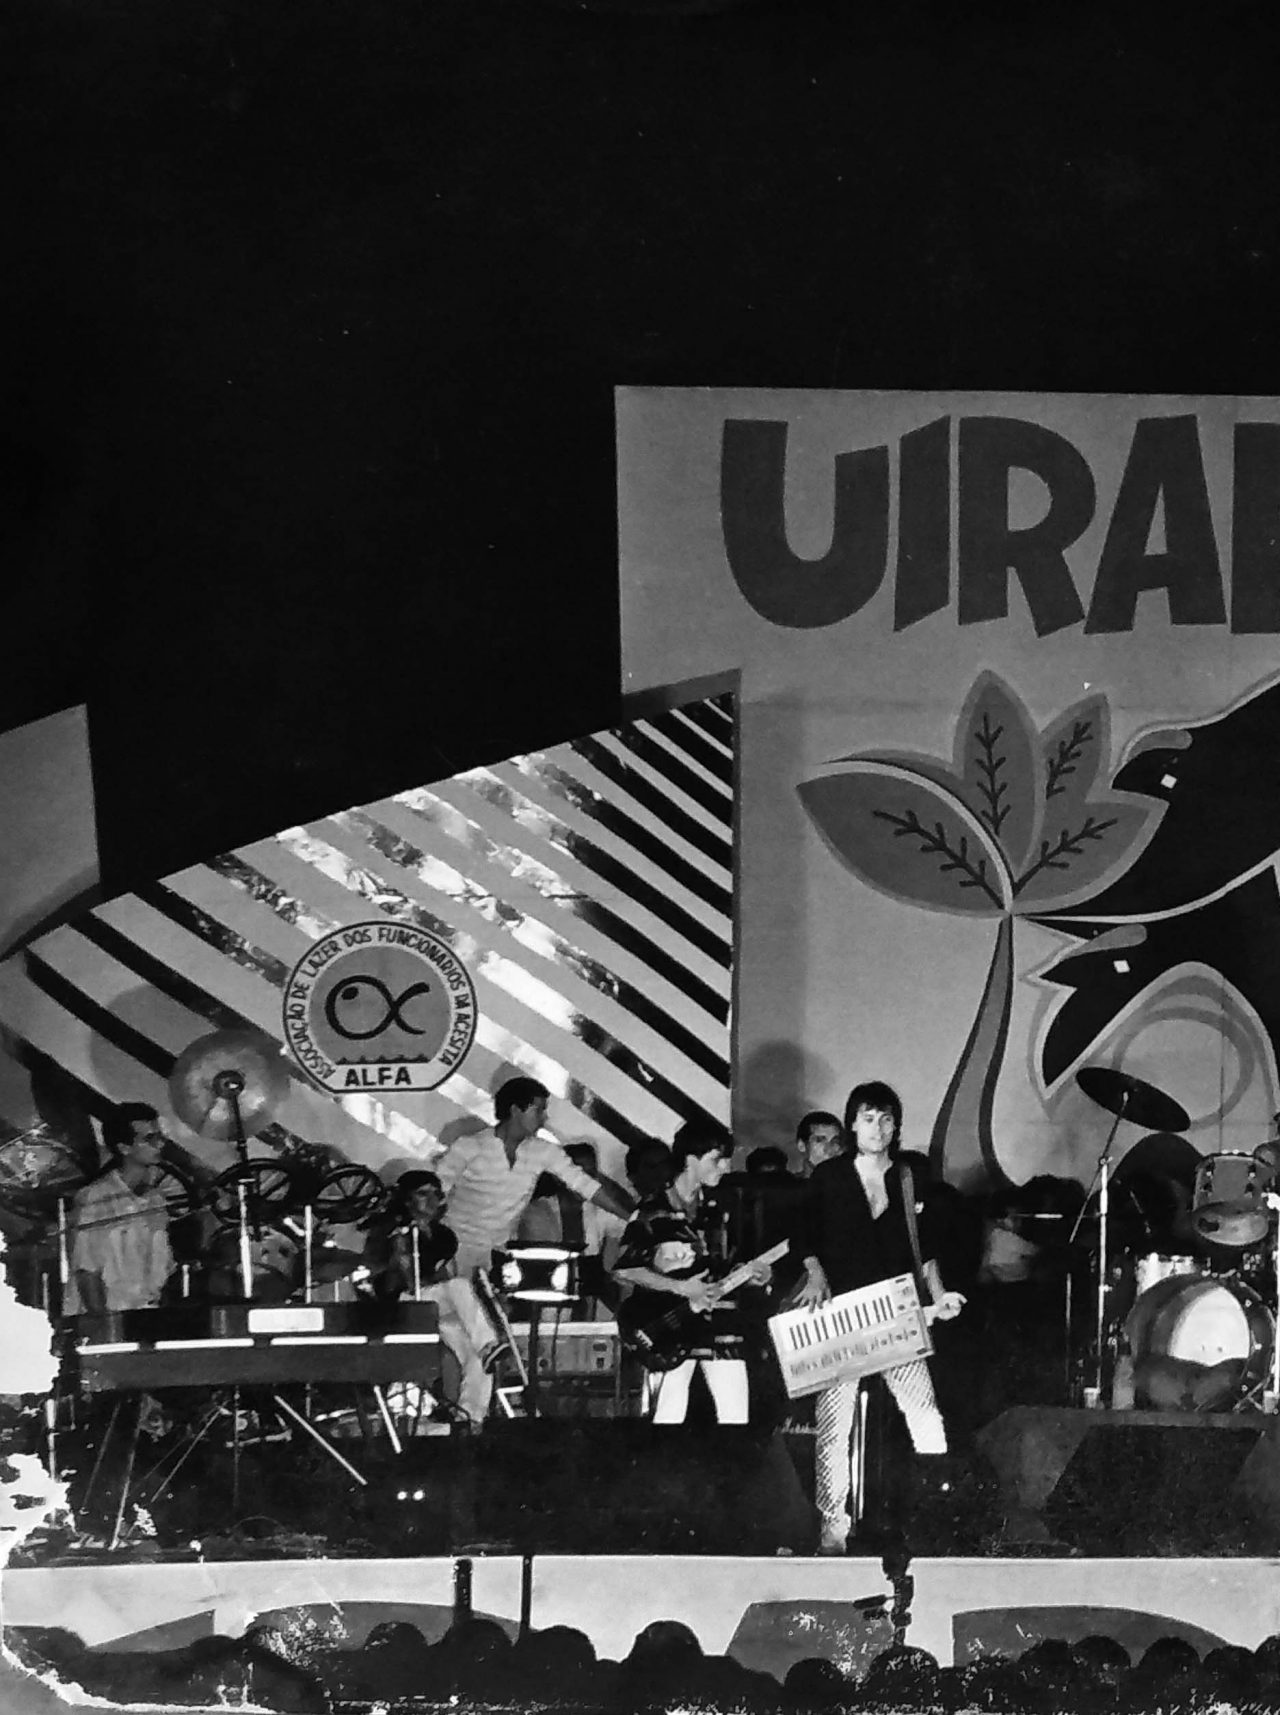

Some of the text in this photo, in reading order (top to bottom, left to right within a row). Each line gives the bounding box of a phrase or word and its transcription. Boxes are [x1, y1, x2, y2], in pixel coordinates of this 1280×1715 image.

[343, 929, 372, 947] DOS
[300, 940, 342, 978] LAZER
[290, 982, 310, 1000] DE
[454, 993, 471, 1010] DA
[438, 1013, 471, 1067] ACESITA
[345, 1066, 412, 1087] ALFA
